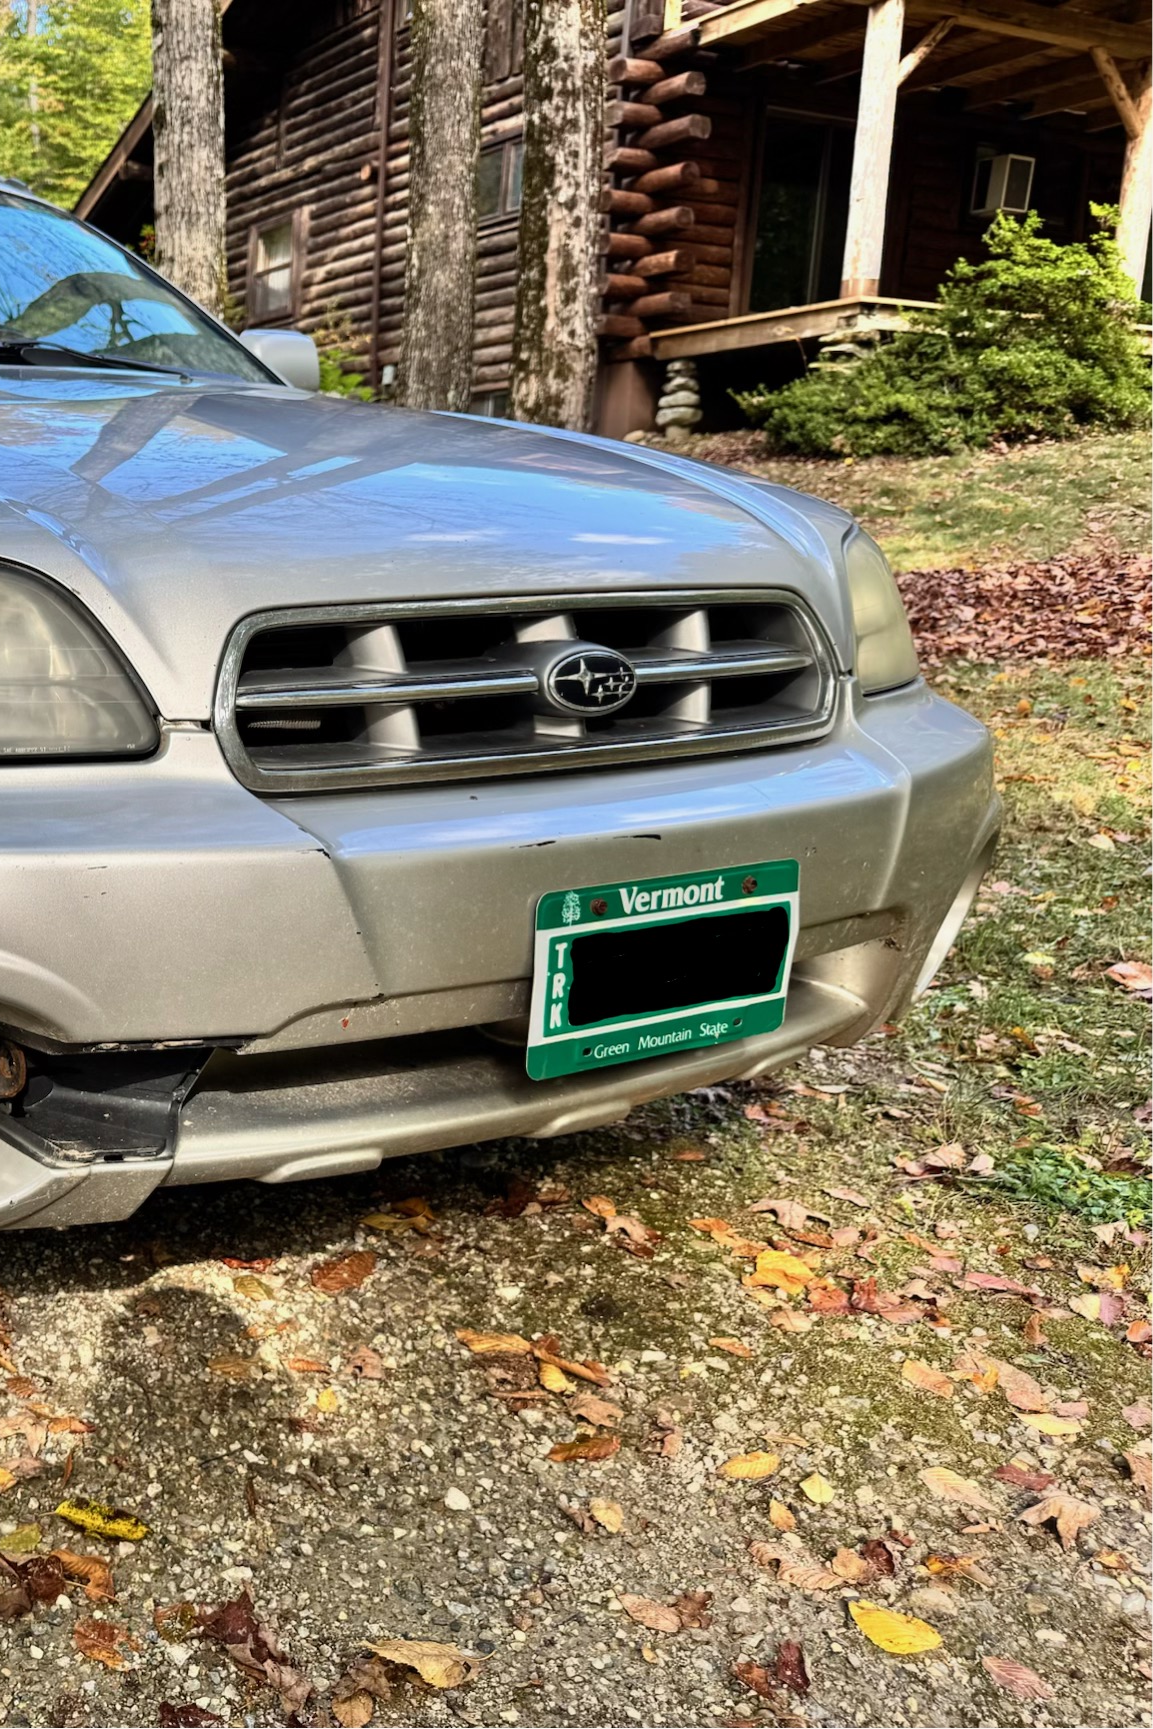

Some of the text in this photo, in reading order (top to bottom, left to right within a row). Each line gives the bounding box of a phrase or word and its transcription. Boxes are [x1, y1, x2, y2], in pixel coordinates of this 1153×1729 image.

[619, 876, 725, 914] Vermont
[549, 942, 568, 1030] TRK
[594, 1018, 729, 1059] Green Mountain State
